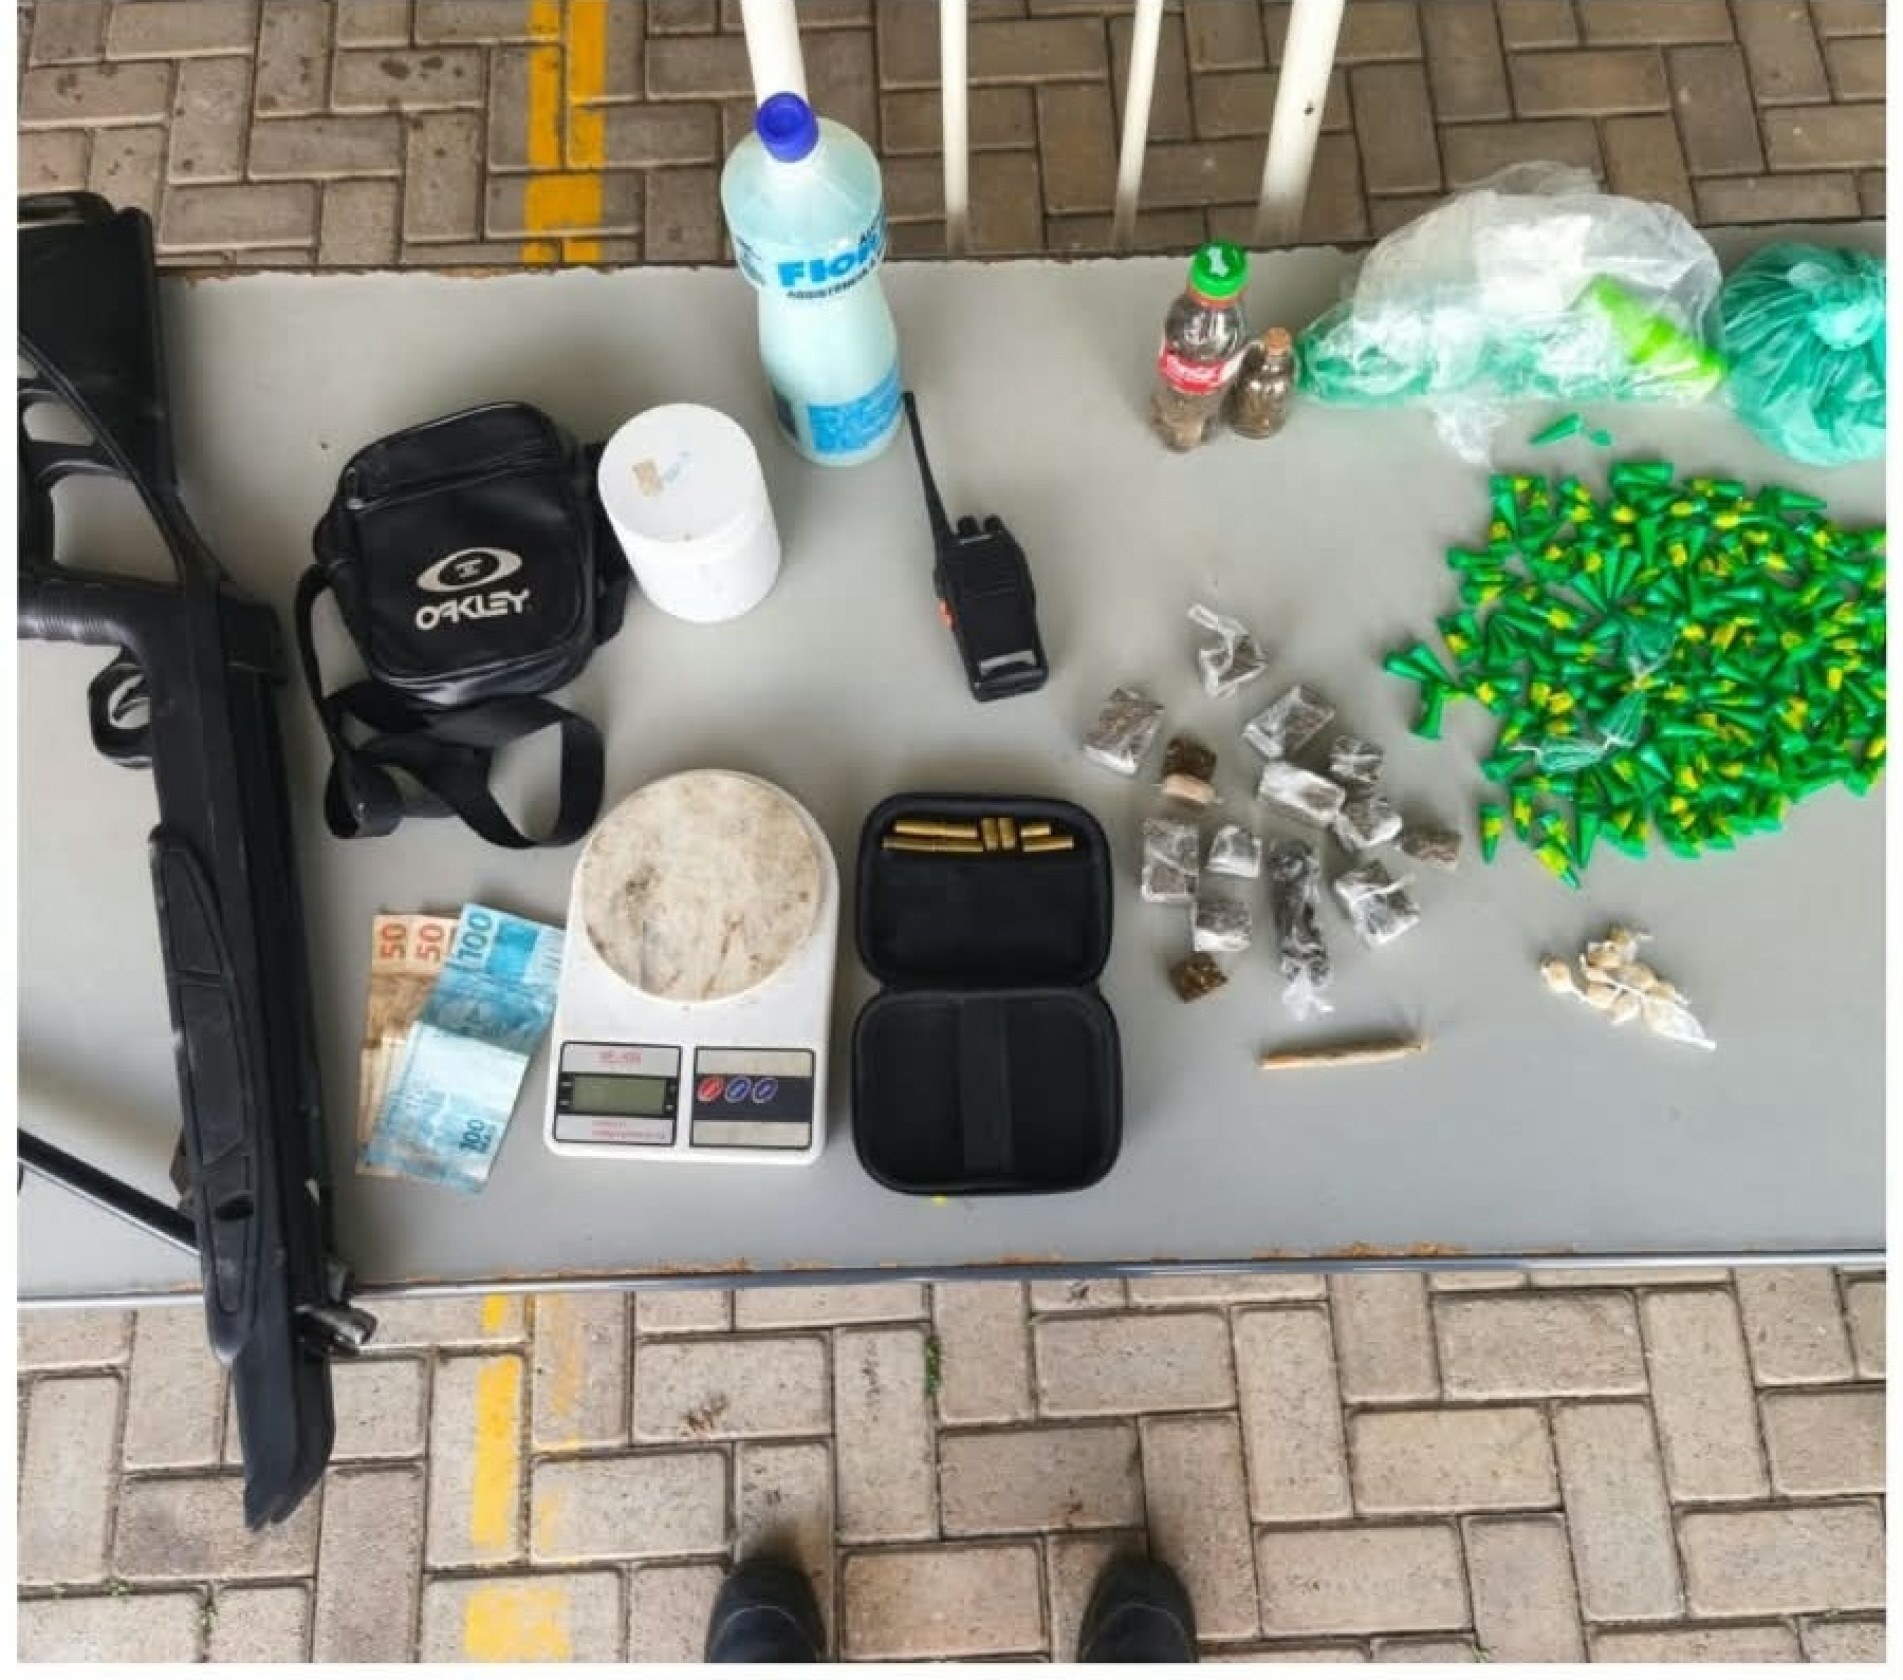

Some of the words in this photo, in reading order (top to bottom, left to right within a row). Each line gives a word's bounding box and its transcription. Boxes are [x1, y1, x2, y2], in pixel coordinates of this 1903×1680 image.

[415, 588, 530, 631] OAKLEY
[380, 923, 407, 960] 50
[416, 923, 444, 961] 50
[458, 912, 492, 960] 100
